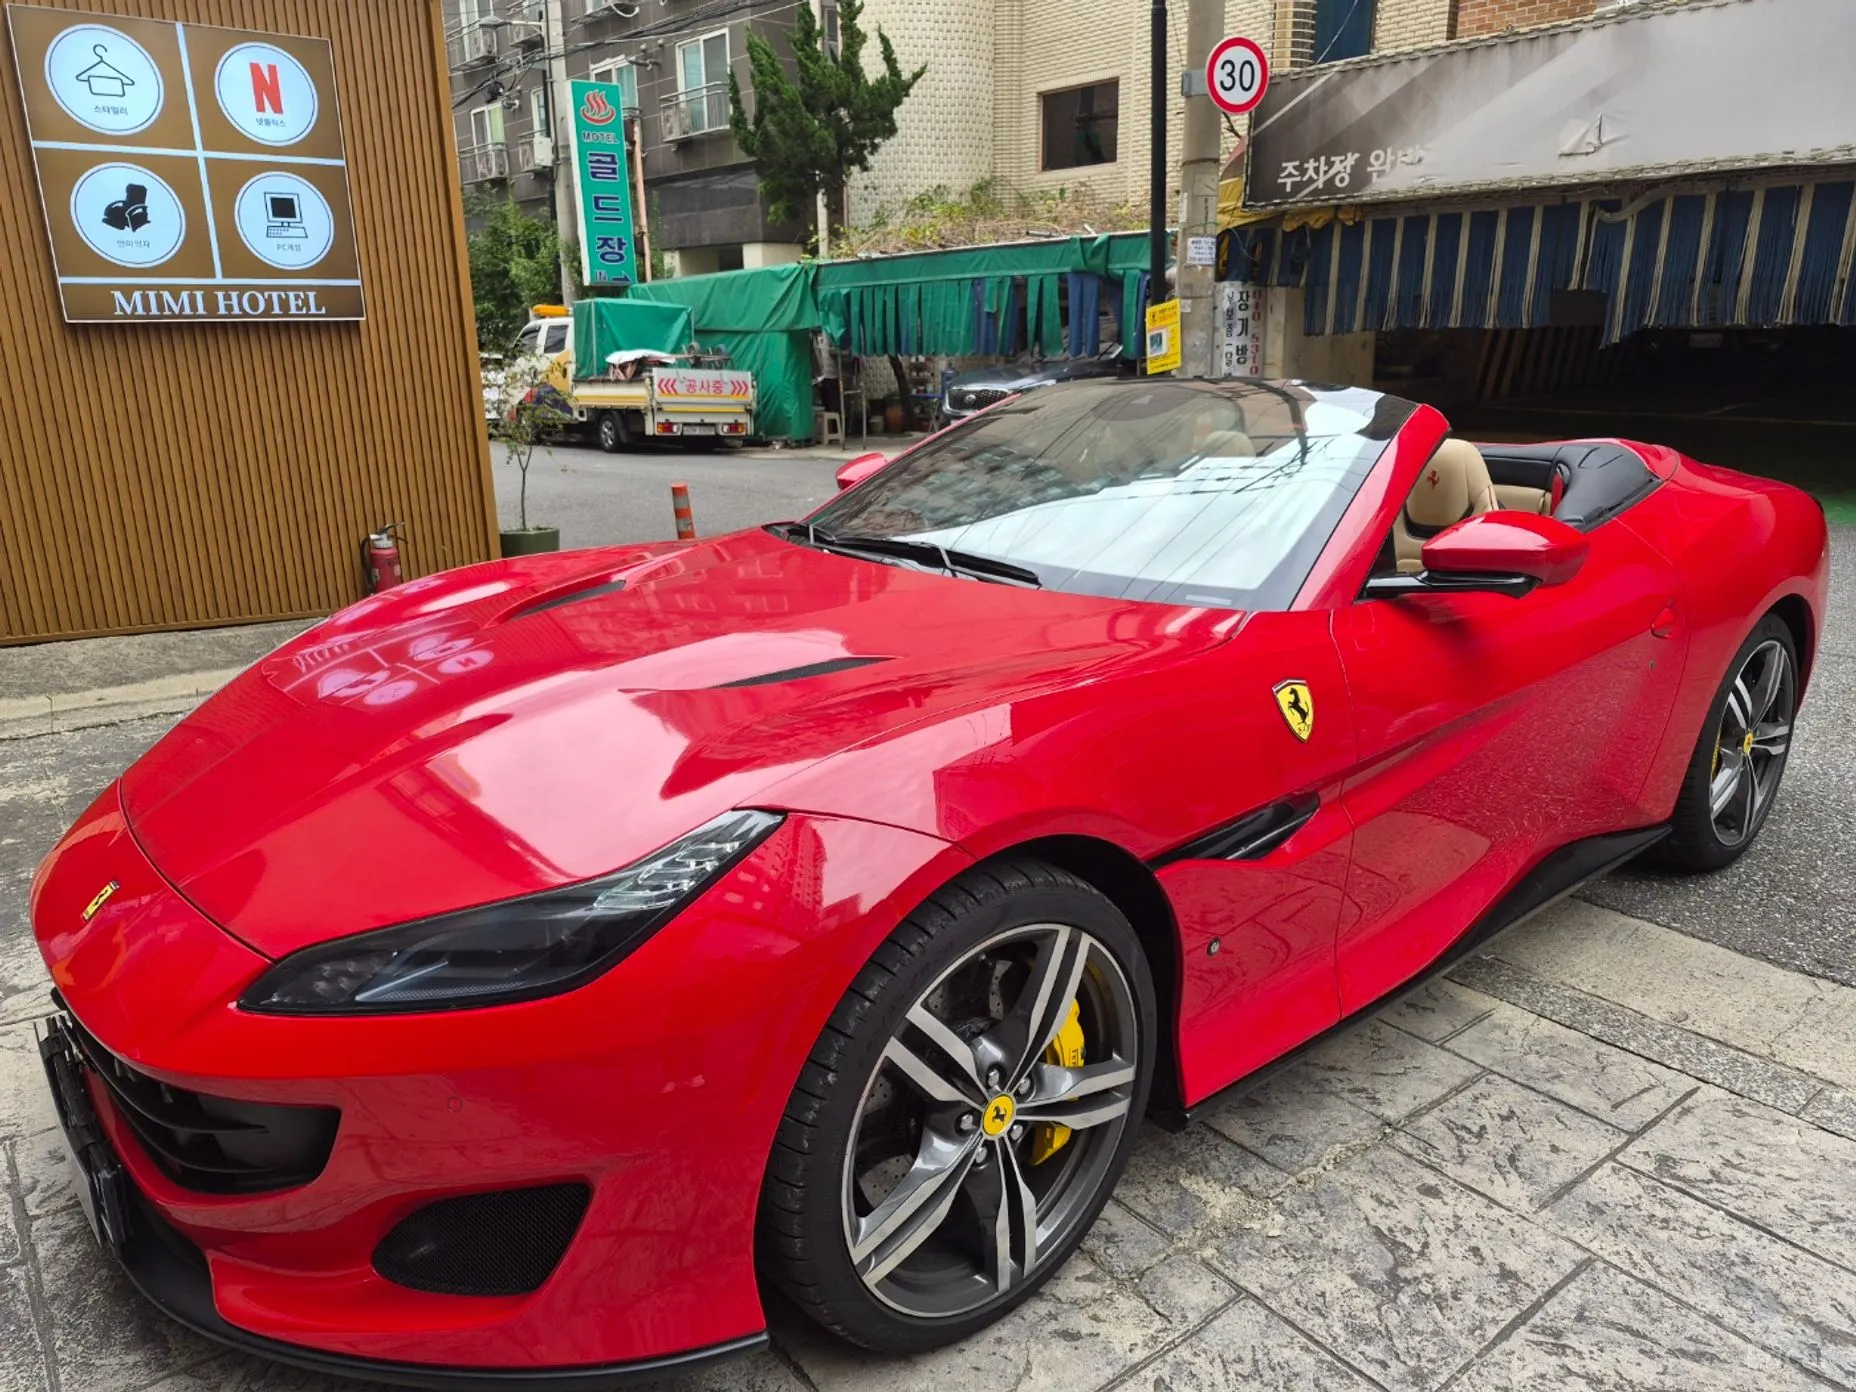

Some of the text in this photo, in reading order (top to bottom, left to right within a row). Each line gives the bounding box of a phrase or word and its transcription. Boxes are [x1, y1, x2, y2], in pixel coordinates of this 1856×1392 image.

[249, 62, 284, 114] N
[1219, 59, 1255, 92] 30
[582, 131, 619, 144] MOTEL
[1277, 152, 1358, 193] 주차장
[588, 152, 627, 265] 골드장
[110, 290, 326, 315] MIMI HOTEL
[1236, 290, 1250, 365] 장기방
[685, 379, 724, 394] 공사중
